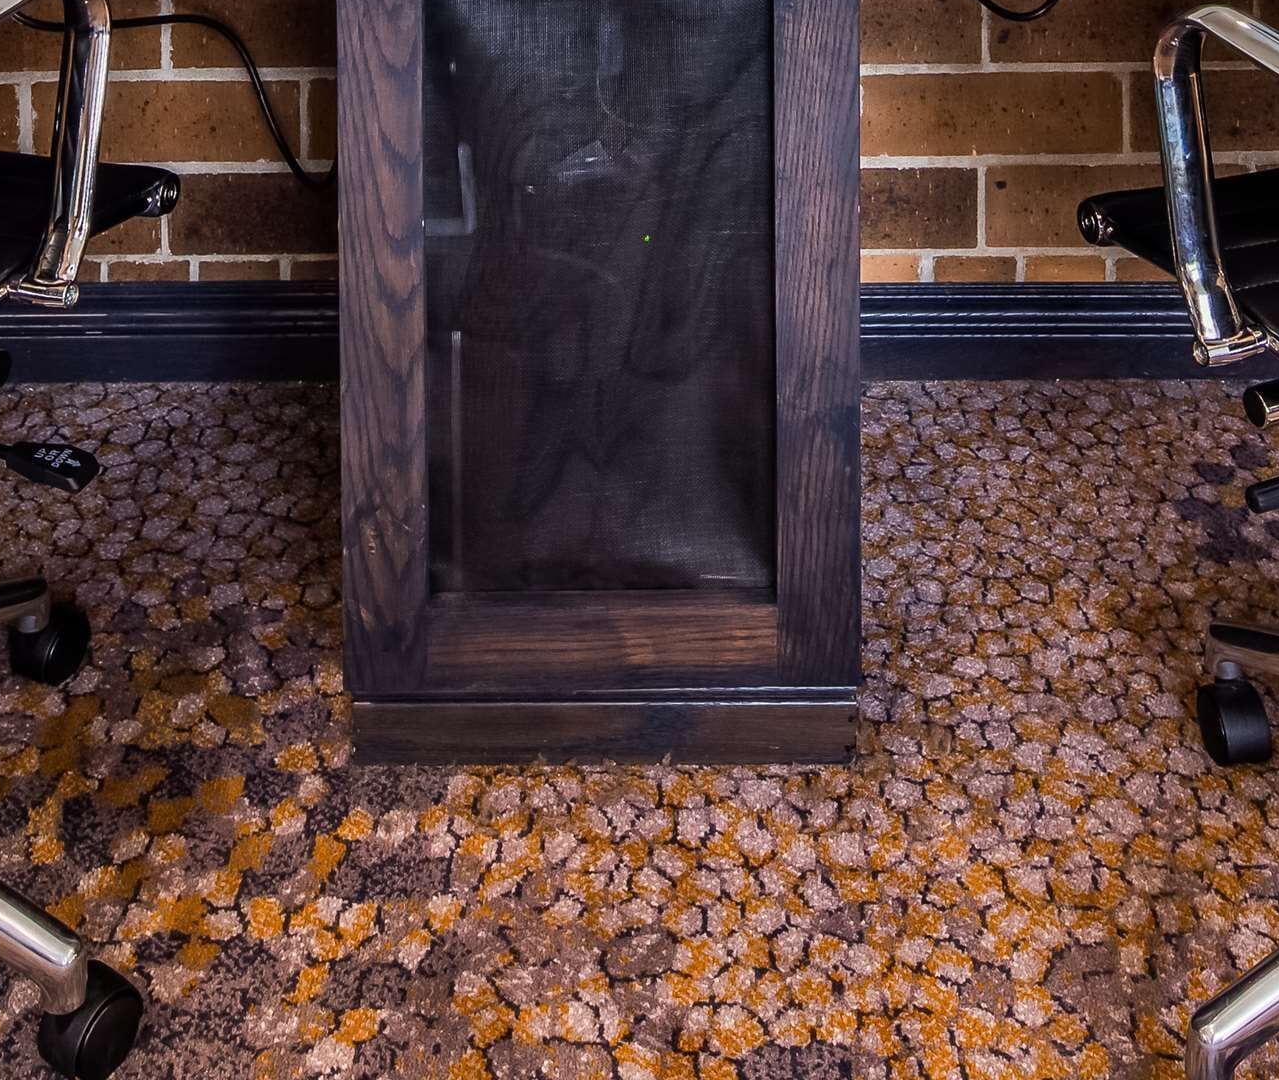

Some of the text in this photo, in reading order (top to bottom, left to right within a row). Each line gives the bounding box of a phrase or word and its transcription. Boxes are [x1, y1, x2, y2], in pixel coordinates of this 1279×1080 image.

[33, 448, 47, 459] UP
[44, 449, 60, 461] OR
[50, 448, 73, 468] DOWN
